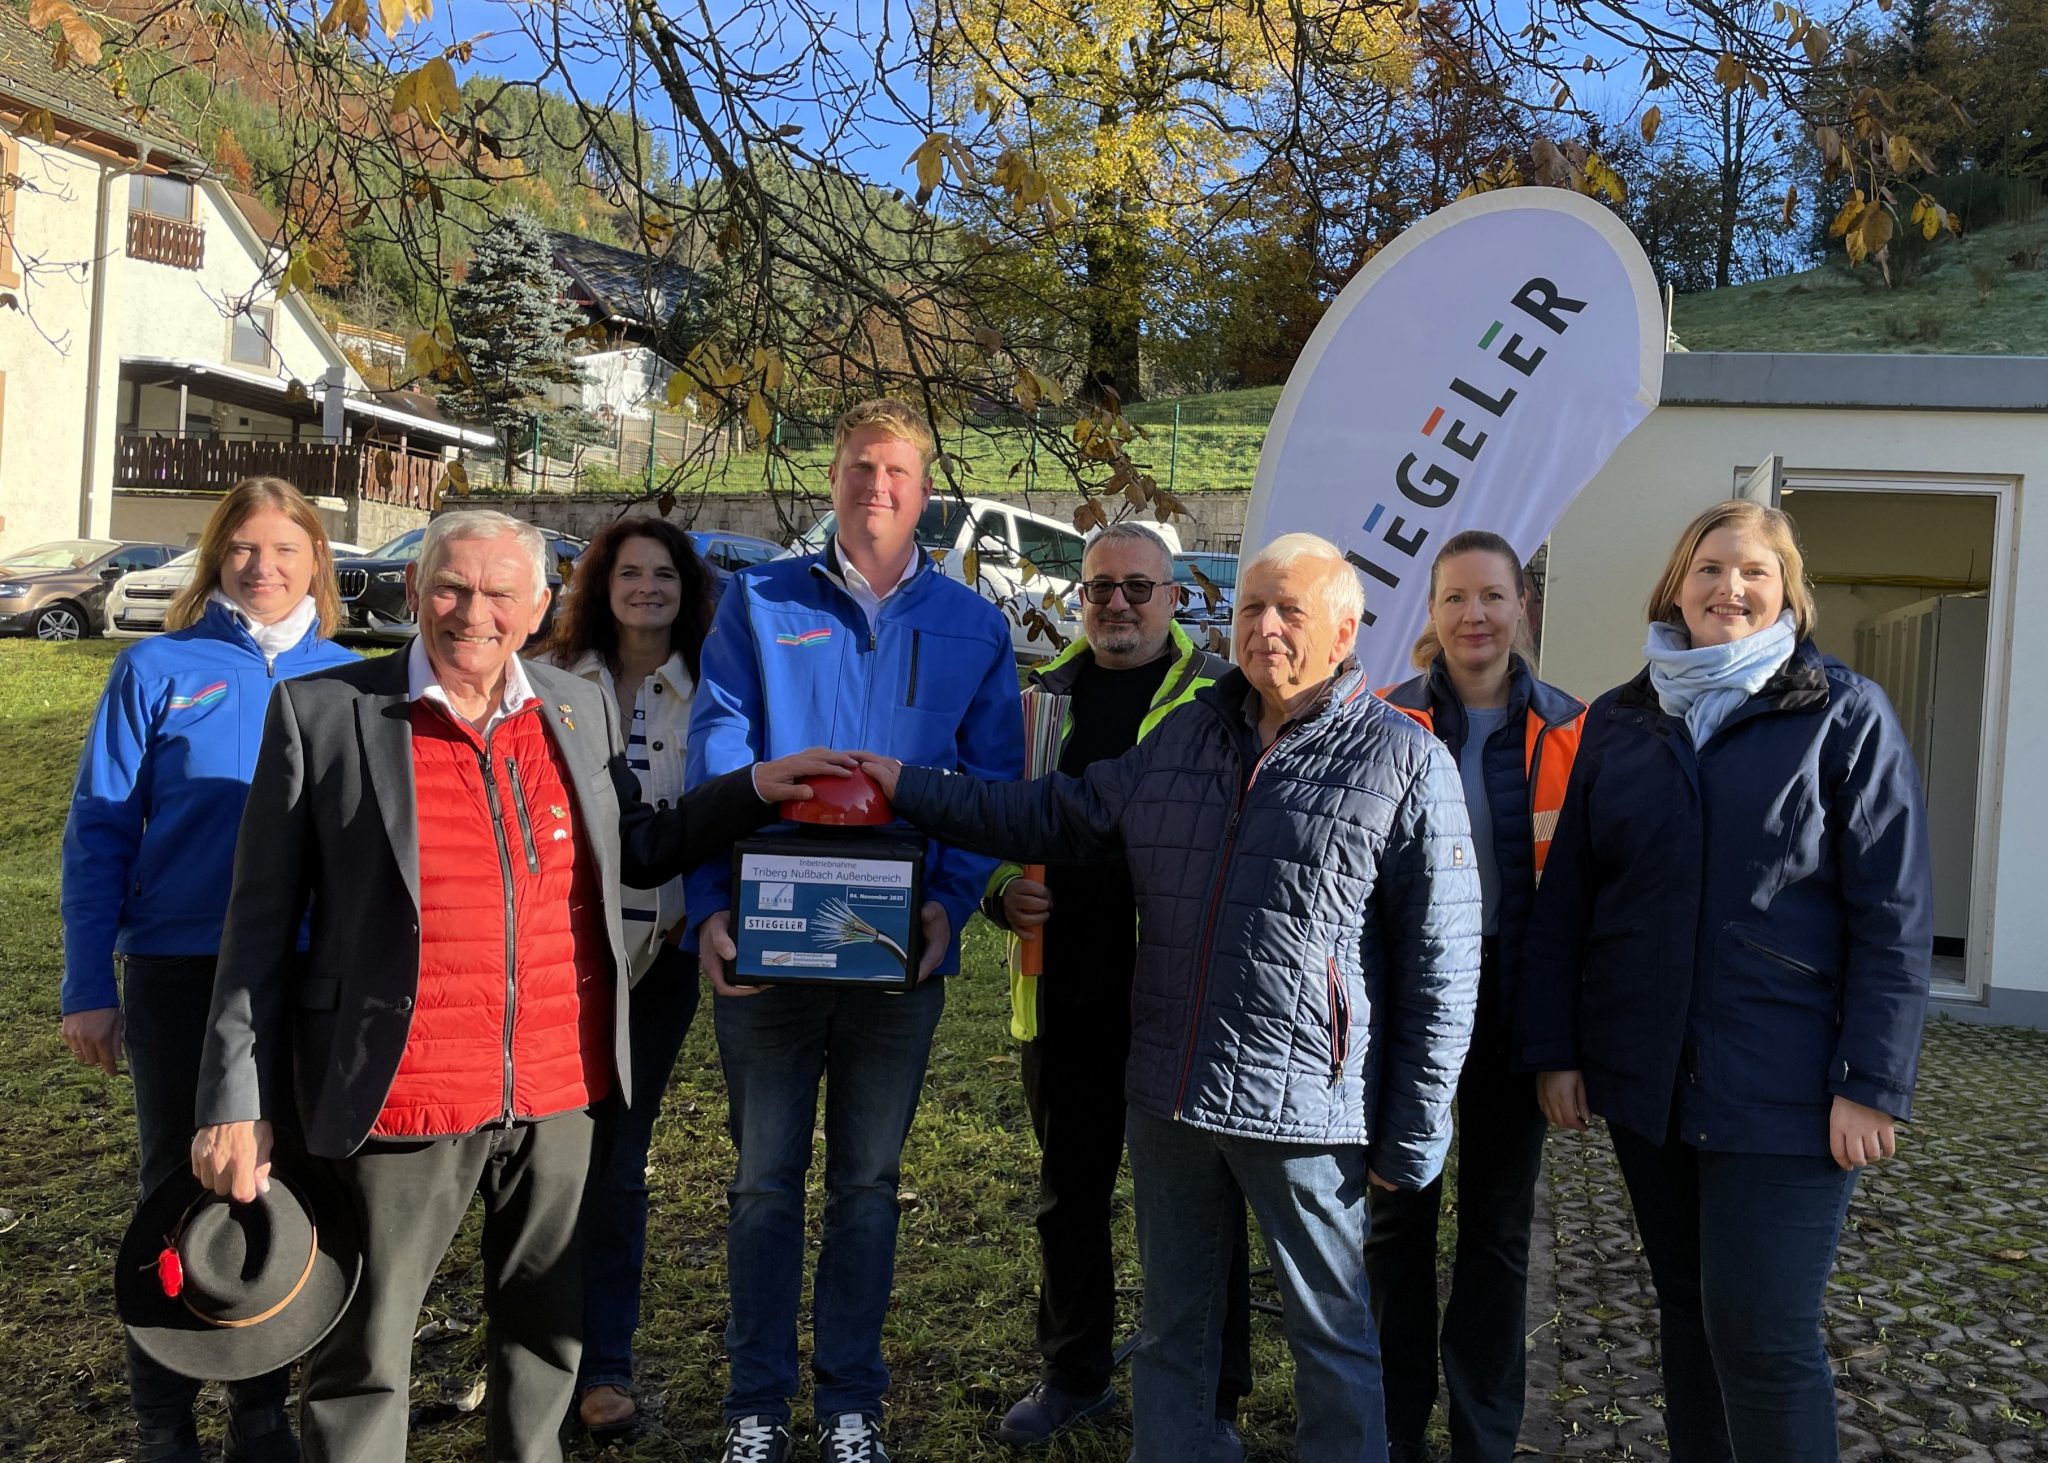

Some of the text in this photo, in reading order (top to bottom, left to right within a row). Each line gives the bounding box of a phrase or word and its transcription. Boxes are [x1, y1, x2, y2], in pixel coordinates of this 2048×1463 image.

[1345, 276, 1588, 628] IEGELER
[799, 859, 857, 869] Inbetriebnahme
[752, 867, 901, 883] Triberg Nußbach Außenbereich
[748, 919, 803, 930] STIEGELER
